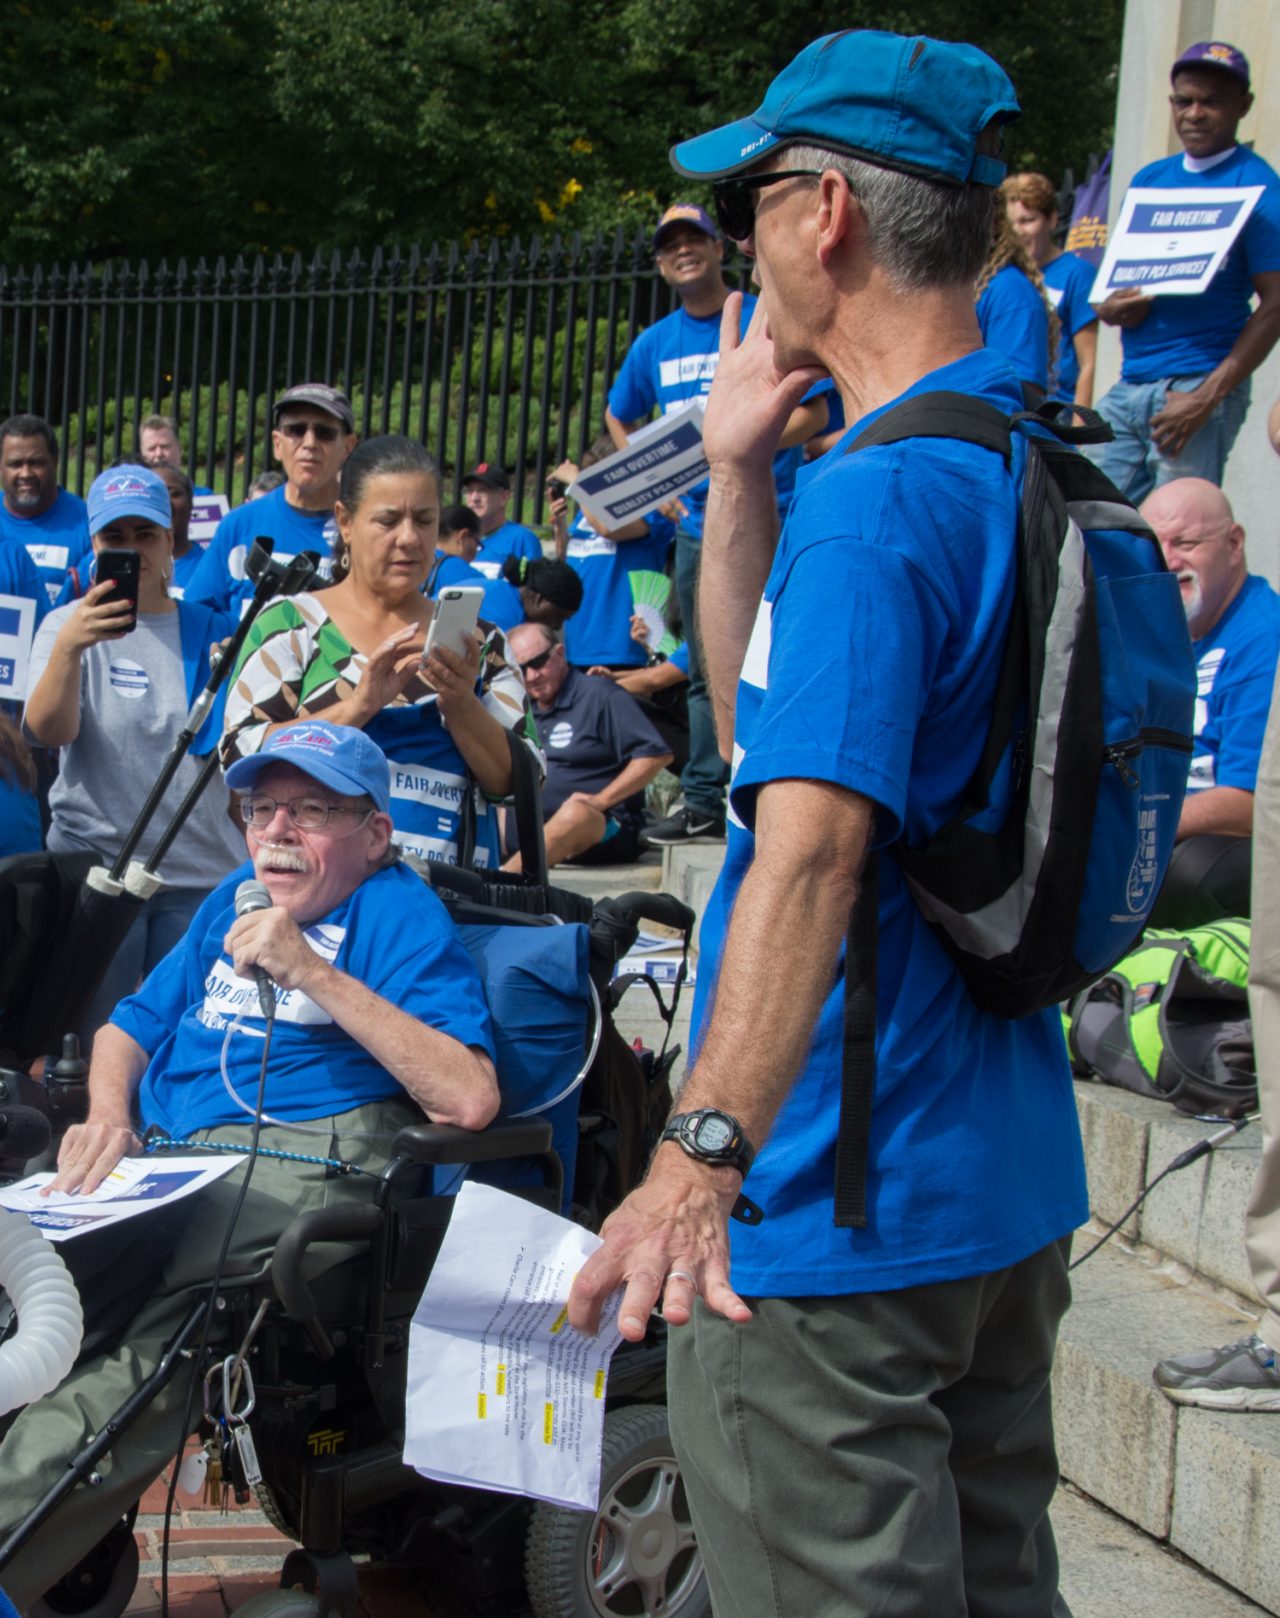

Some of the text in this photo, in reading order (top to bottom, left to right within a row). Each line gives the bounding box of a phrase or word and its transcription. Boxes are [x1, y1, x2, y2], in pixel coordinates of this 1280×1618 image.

[1151, 209, 1222, 227] FAIR OVERTIME
[1112, 260, 1207, 282] QUALITY PCA SERVICES
[604, 439, 678, 483] FAIR OVERTIME
[613, 491, 652, 515] QUALITY
[653, 481, 673, 497] PCA
[396, 772, 429, 793] FAIR
